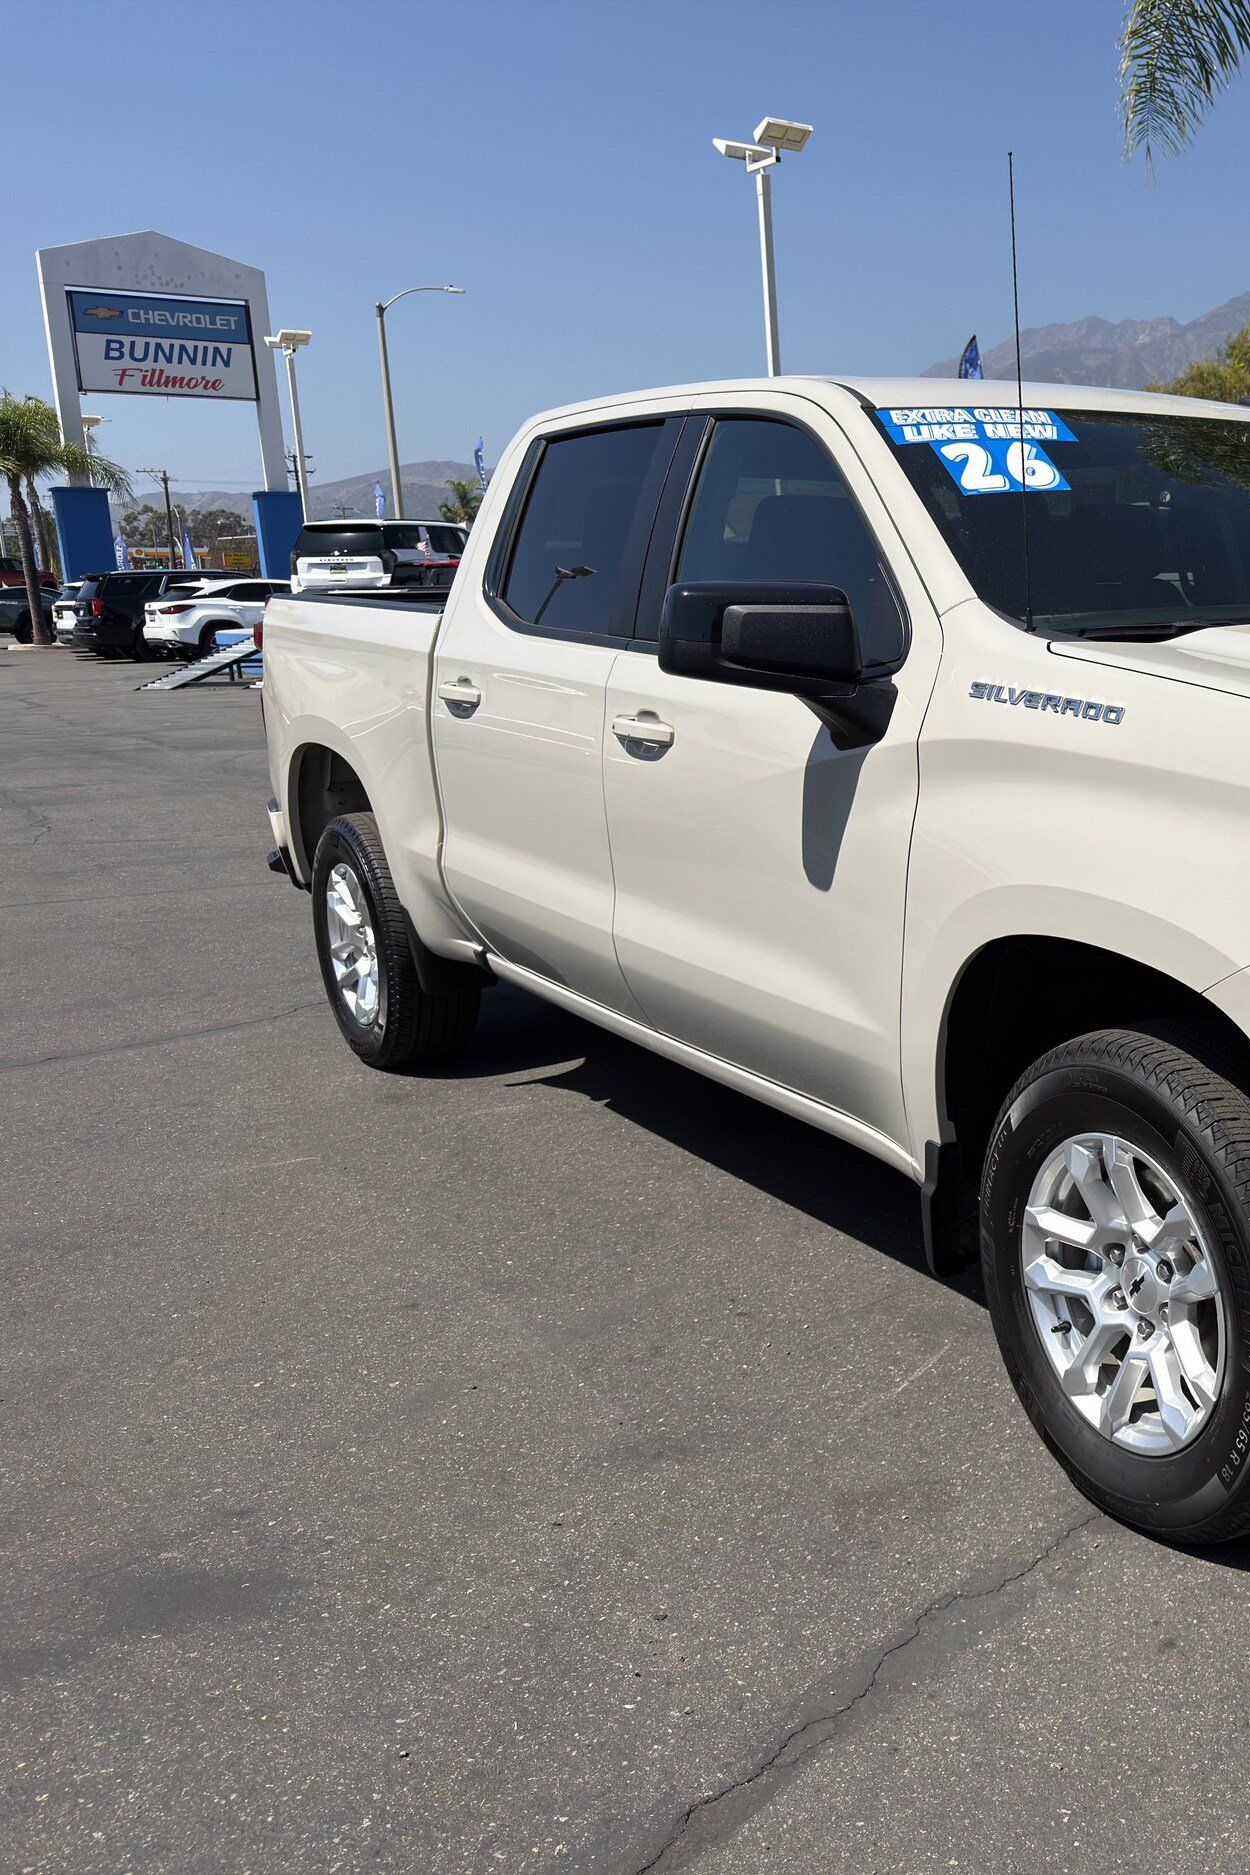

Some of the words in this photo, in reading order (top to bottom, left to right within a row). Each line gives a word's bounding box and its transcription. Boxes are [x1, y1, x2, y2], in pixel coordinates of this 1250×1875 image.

[127, 308, 238, 330] CHEVROLET
[104, 338, 232, 368] BUNNIN
[112, 368, 225, 392] Fillmore
[889, 408, 973, 425] EXTRA
[973, 408, 1052, 425] CLEAN
[902, 423, 979, 441] LIKE
[983, 424, 1058, 440] NEW
[940, 441, 1060, 492] 26
[968, 681, 1126, 725] SILVERADO
[1230, 1449, 1241, 1466] R
[1221, 1464, 1234, 1482] 18
